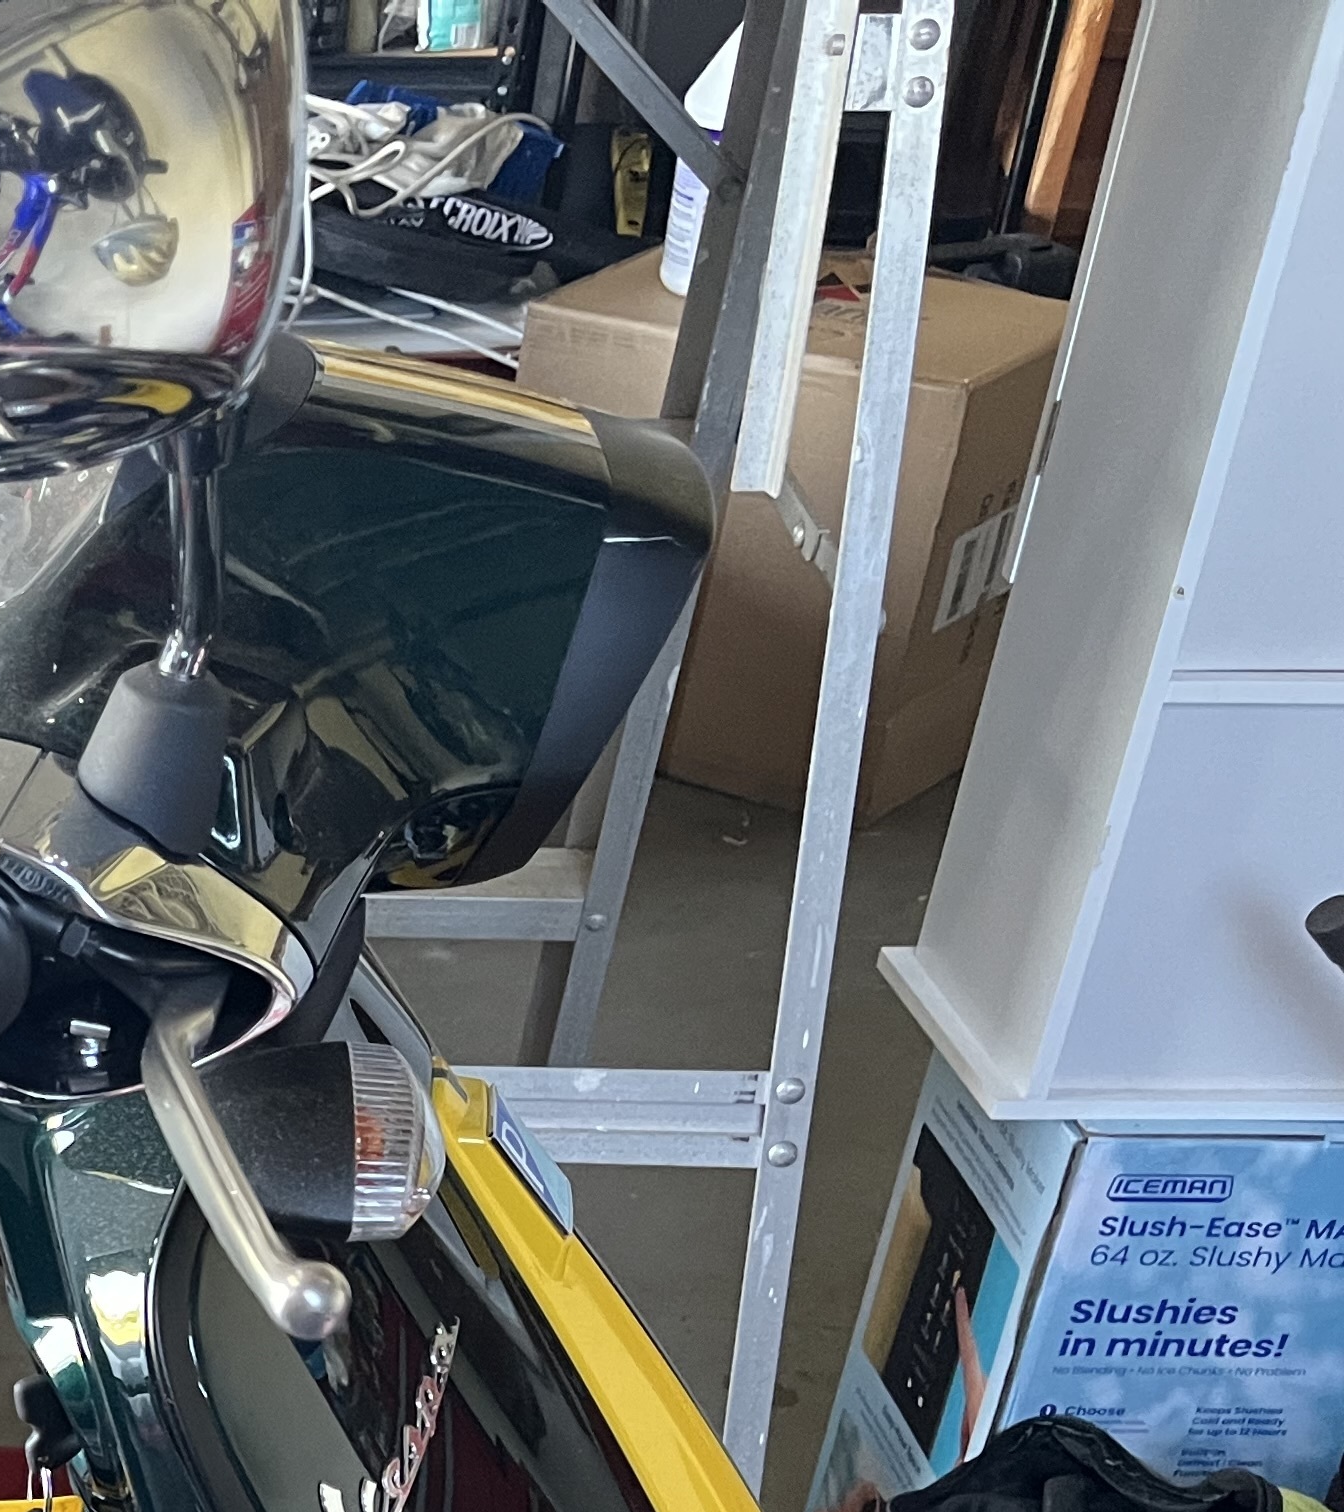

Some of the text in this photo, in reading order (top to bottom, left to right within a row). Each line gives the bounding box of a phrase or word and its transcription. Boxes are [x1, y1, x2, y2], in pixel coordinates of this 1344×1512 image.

[1113, 1178, 1227, 1195] ICEMAN
[1090, 1244, 1130, 1267] 64
[1139, 1249, 1178, 1267] oz.
[1189, 1245, 1292, 1275] Slushy
[1069, 1297, 1239, 1325] Slushies
[1058, 1330, 1289, 1359] in minutes!
[1064, 1405, 1126, 1416] Choose
